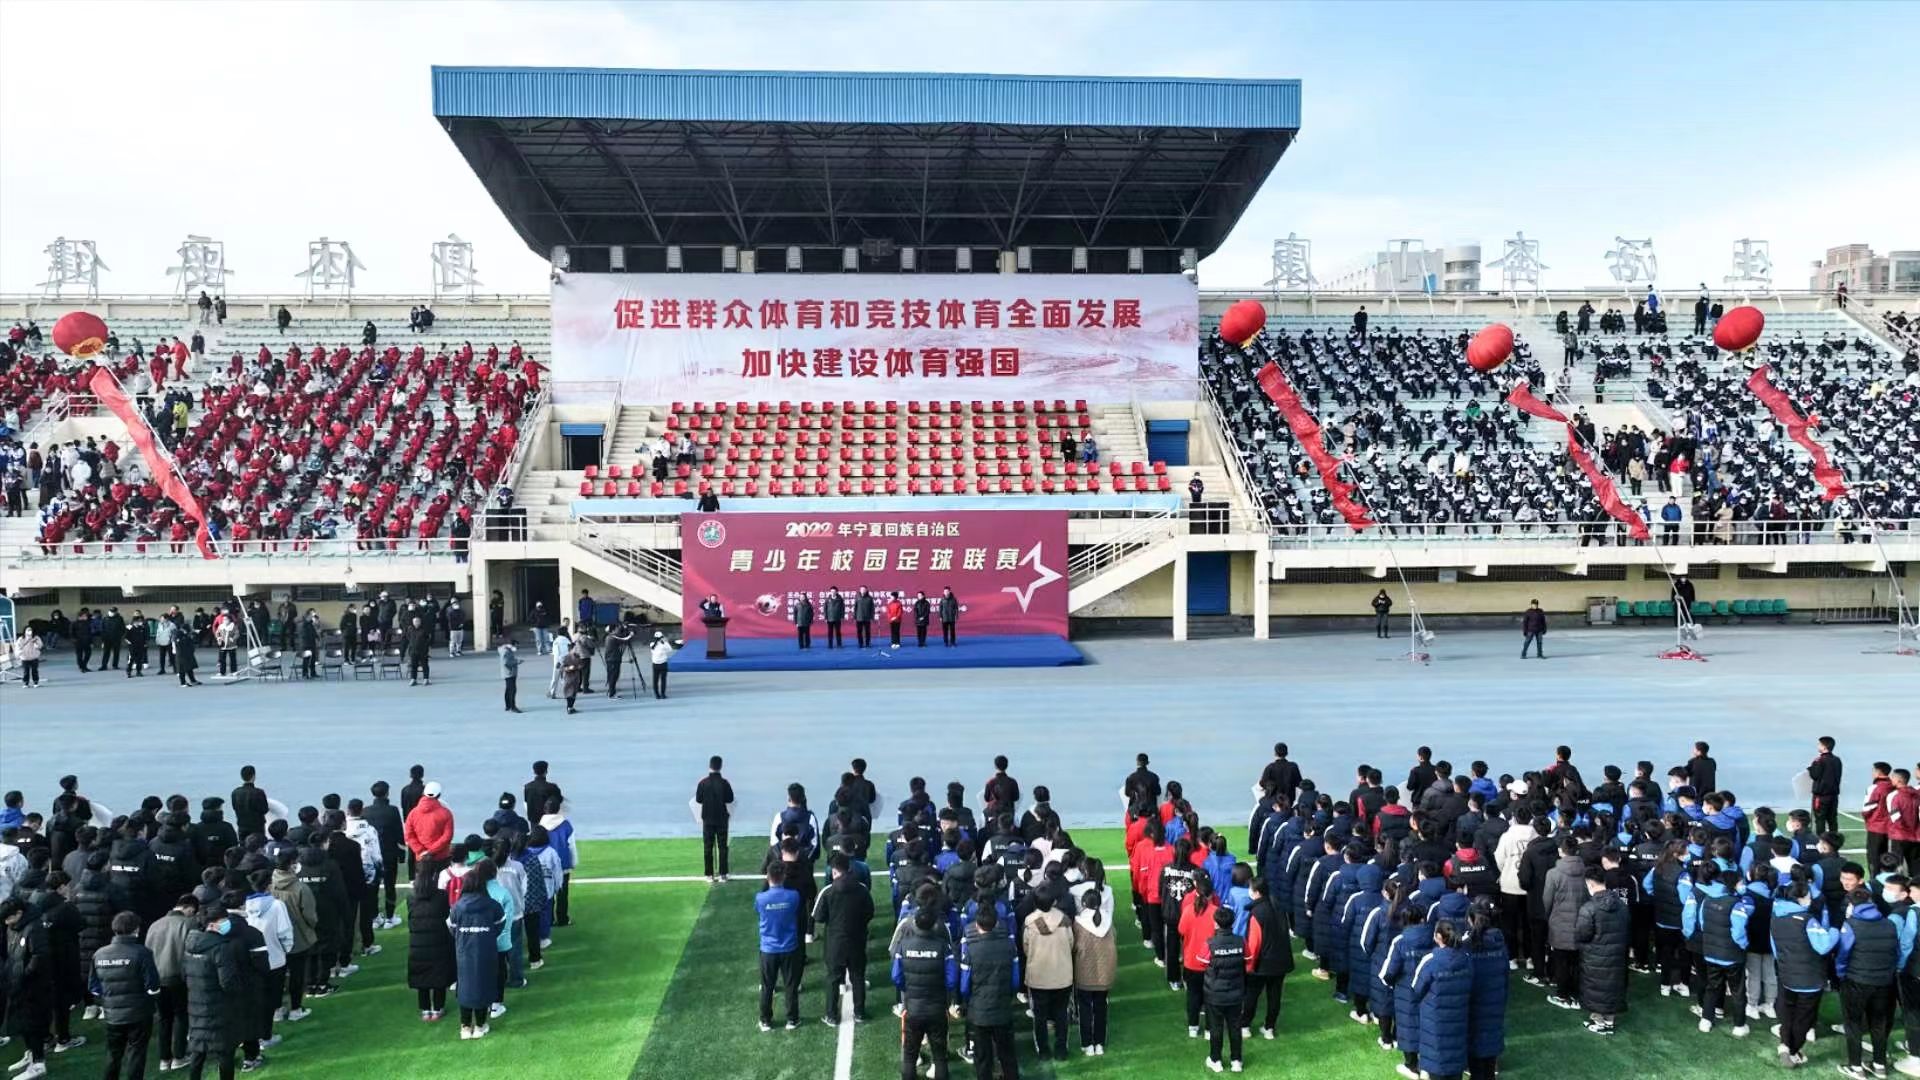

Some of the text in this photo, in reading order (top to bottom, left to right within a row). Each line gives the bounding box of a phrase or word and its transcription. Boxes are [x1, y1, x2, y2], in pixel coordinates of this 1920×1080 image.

[614, 298, 1142, 329] 促进群众体育和竞技体育全面发展
[741, 347, 1020, 378] 加快建设体育强国
[785, 522, 960, 537] 2022 年宁夏回族自治区
[729, 548, 1019, 572] 青少年校园足球联赛
